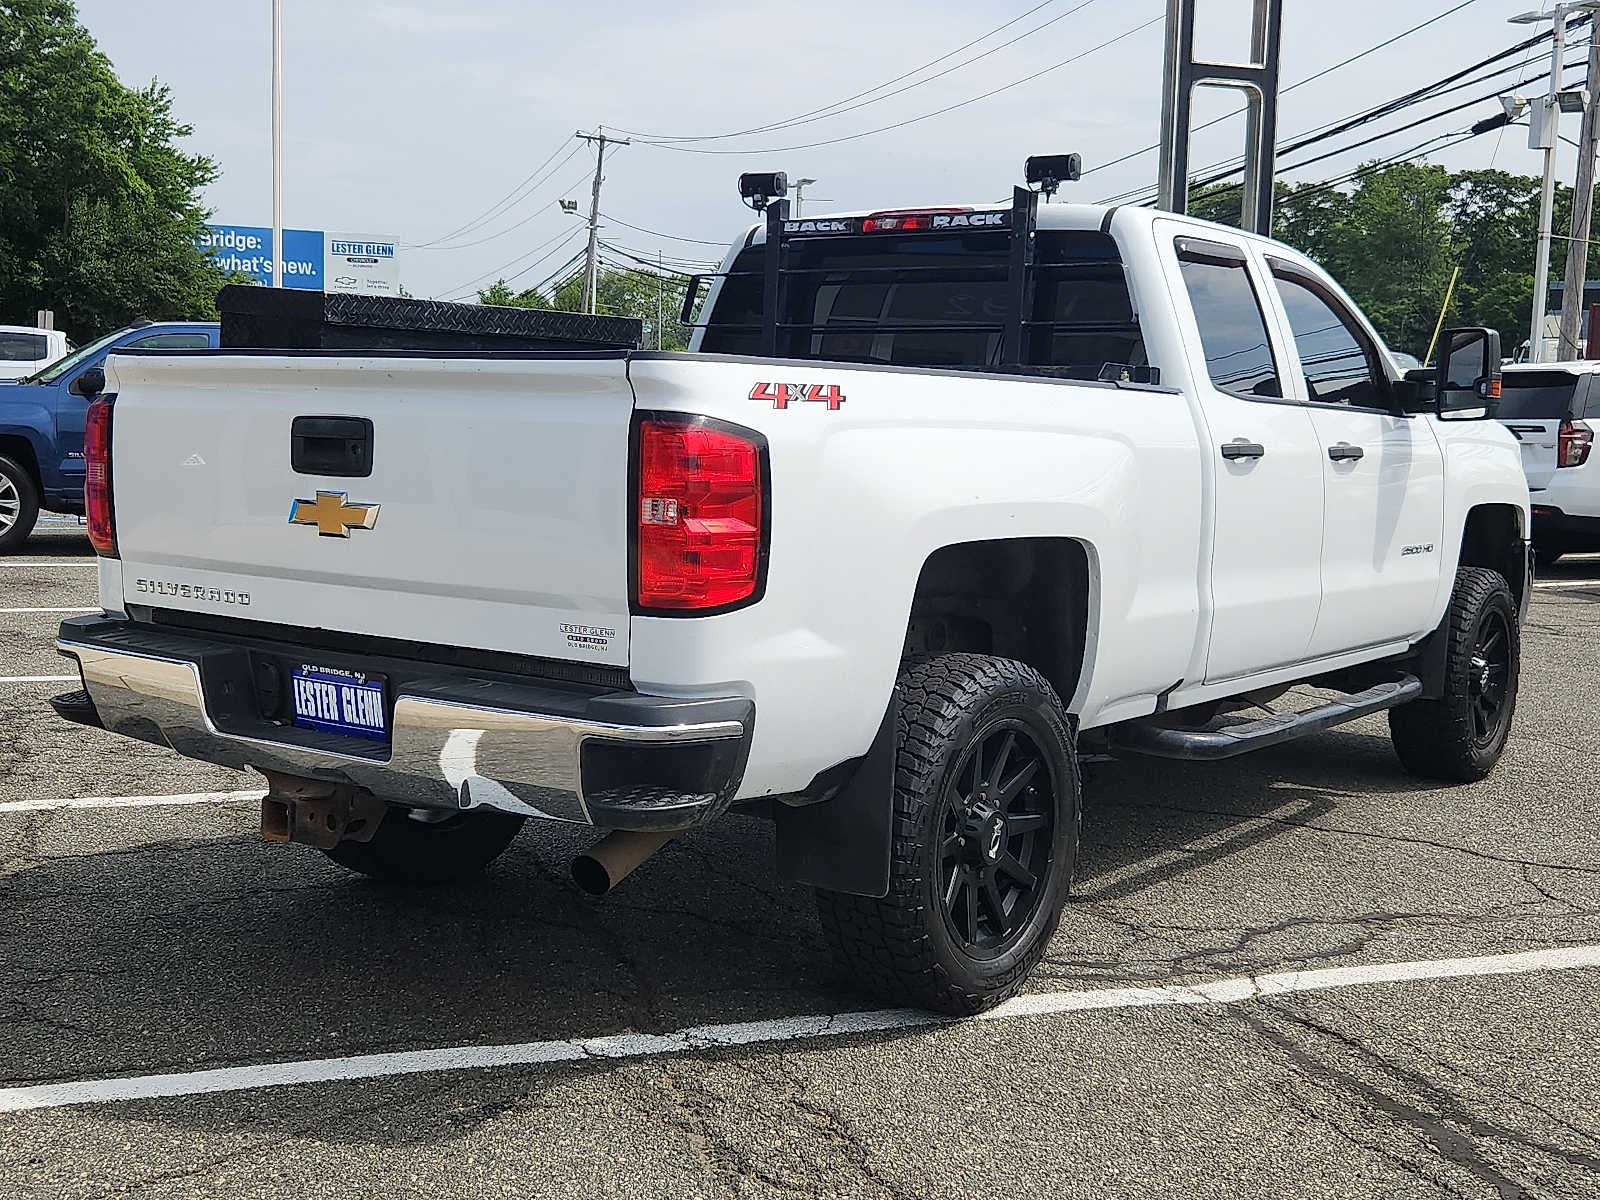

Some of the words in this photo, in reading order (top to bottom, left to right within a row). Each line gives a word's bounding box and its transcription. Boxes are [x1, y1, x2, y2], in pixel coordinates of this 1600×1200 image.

[784, 220, 848, 232] BACK
[933, 213, 1006, 227] RACK
[331, 242, 363, 254] LESTER
[366, 244, 394, 256] GLENN
[136, 579, 251, 605] SILVERADO
[560, 623, 588, 634] LESTER
[590, 627, 616, 638] GLENN
[302, 664, 318, 673] OLD
[320, 667, 353, 678] BRIDGE,
[354, 671, 366, 680] NJ
[293, 679, 339, 721] LESTER
[342, 687, 384, 728] GLENN
